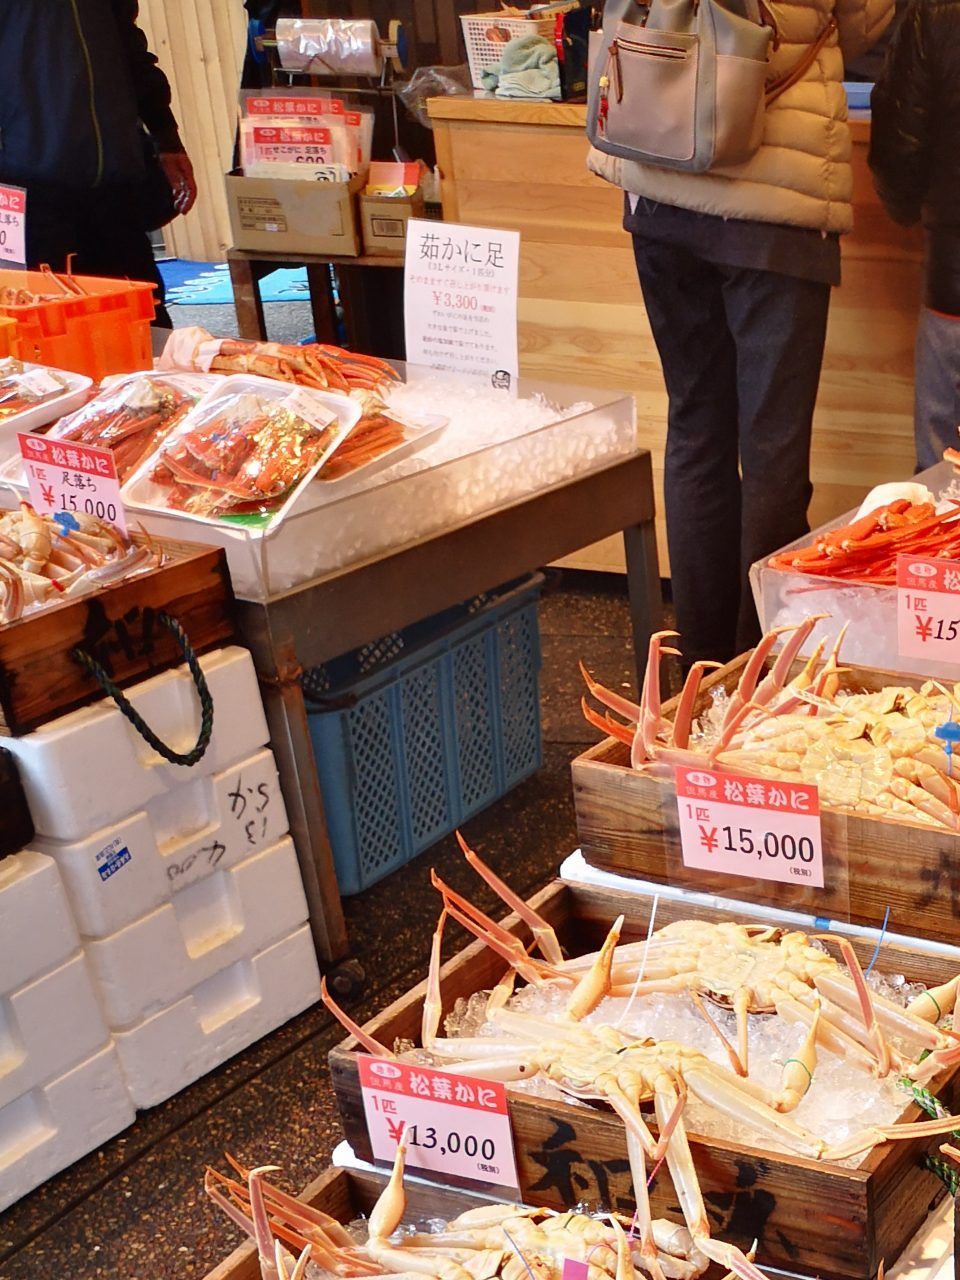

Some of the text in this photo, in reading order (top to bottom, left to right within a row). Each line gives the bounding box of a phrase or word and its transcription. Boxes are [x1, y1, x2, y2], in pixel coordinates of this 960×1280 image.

[420, 233, 505, 268] 茹かに足
[51, 446, 110, 474] 松葉かに
[62, 471, 97, 493] 足落ち
[40, 482, 117, 521] ¥15000
[905, 594, 928, 612] 1匹
[723, 779, 810, 811] 松葉かに
[686, 804, 711, 822] 1匹
[698, 825, 815, 863] ¥15,000
[371, 1095, 399, 1115] 1匹
[409, 1071, 498, 1108] 松葉かに
[385, 1116, 496, 1161] ¥13,000
